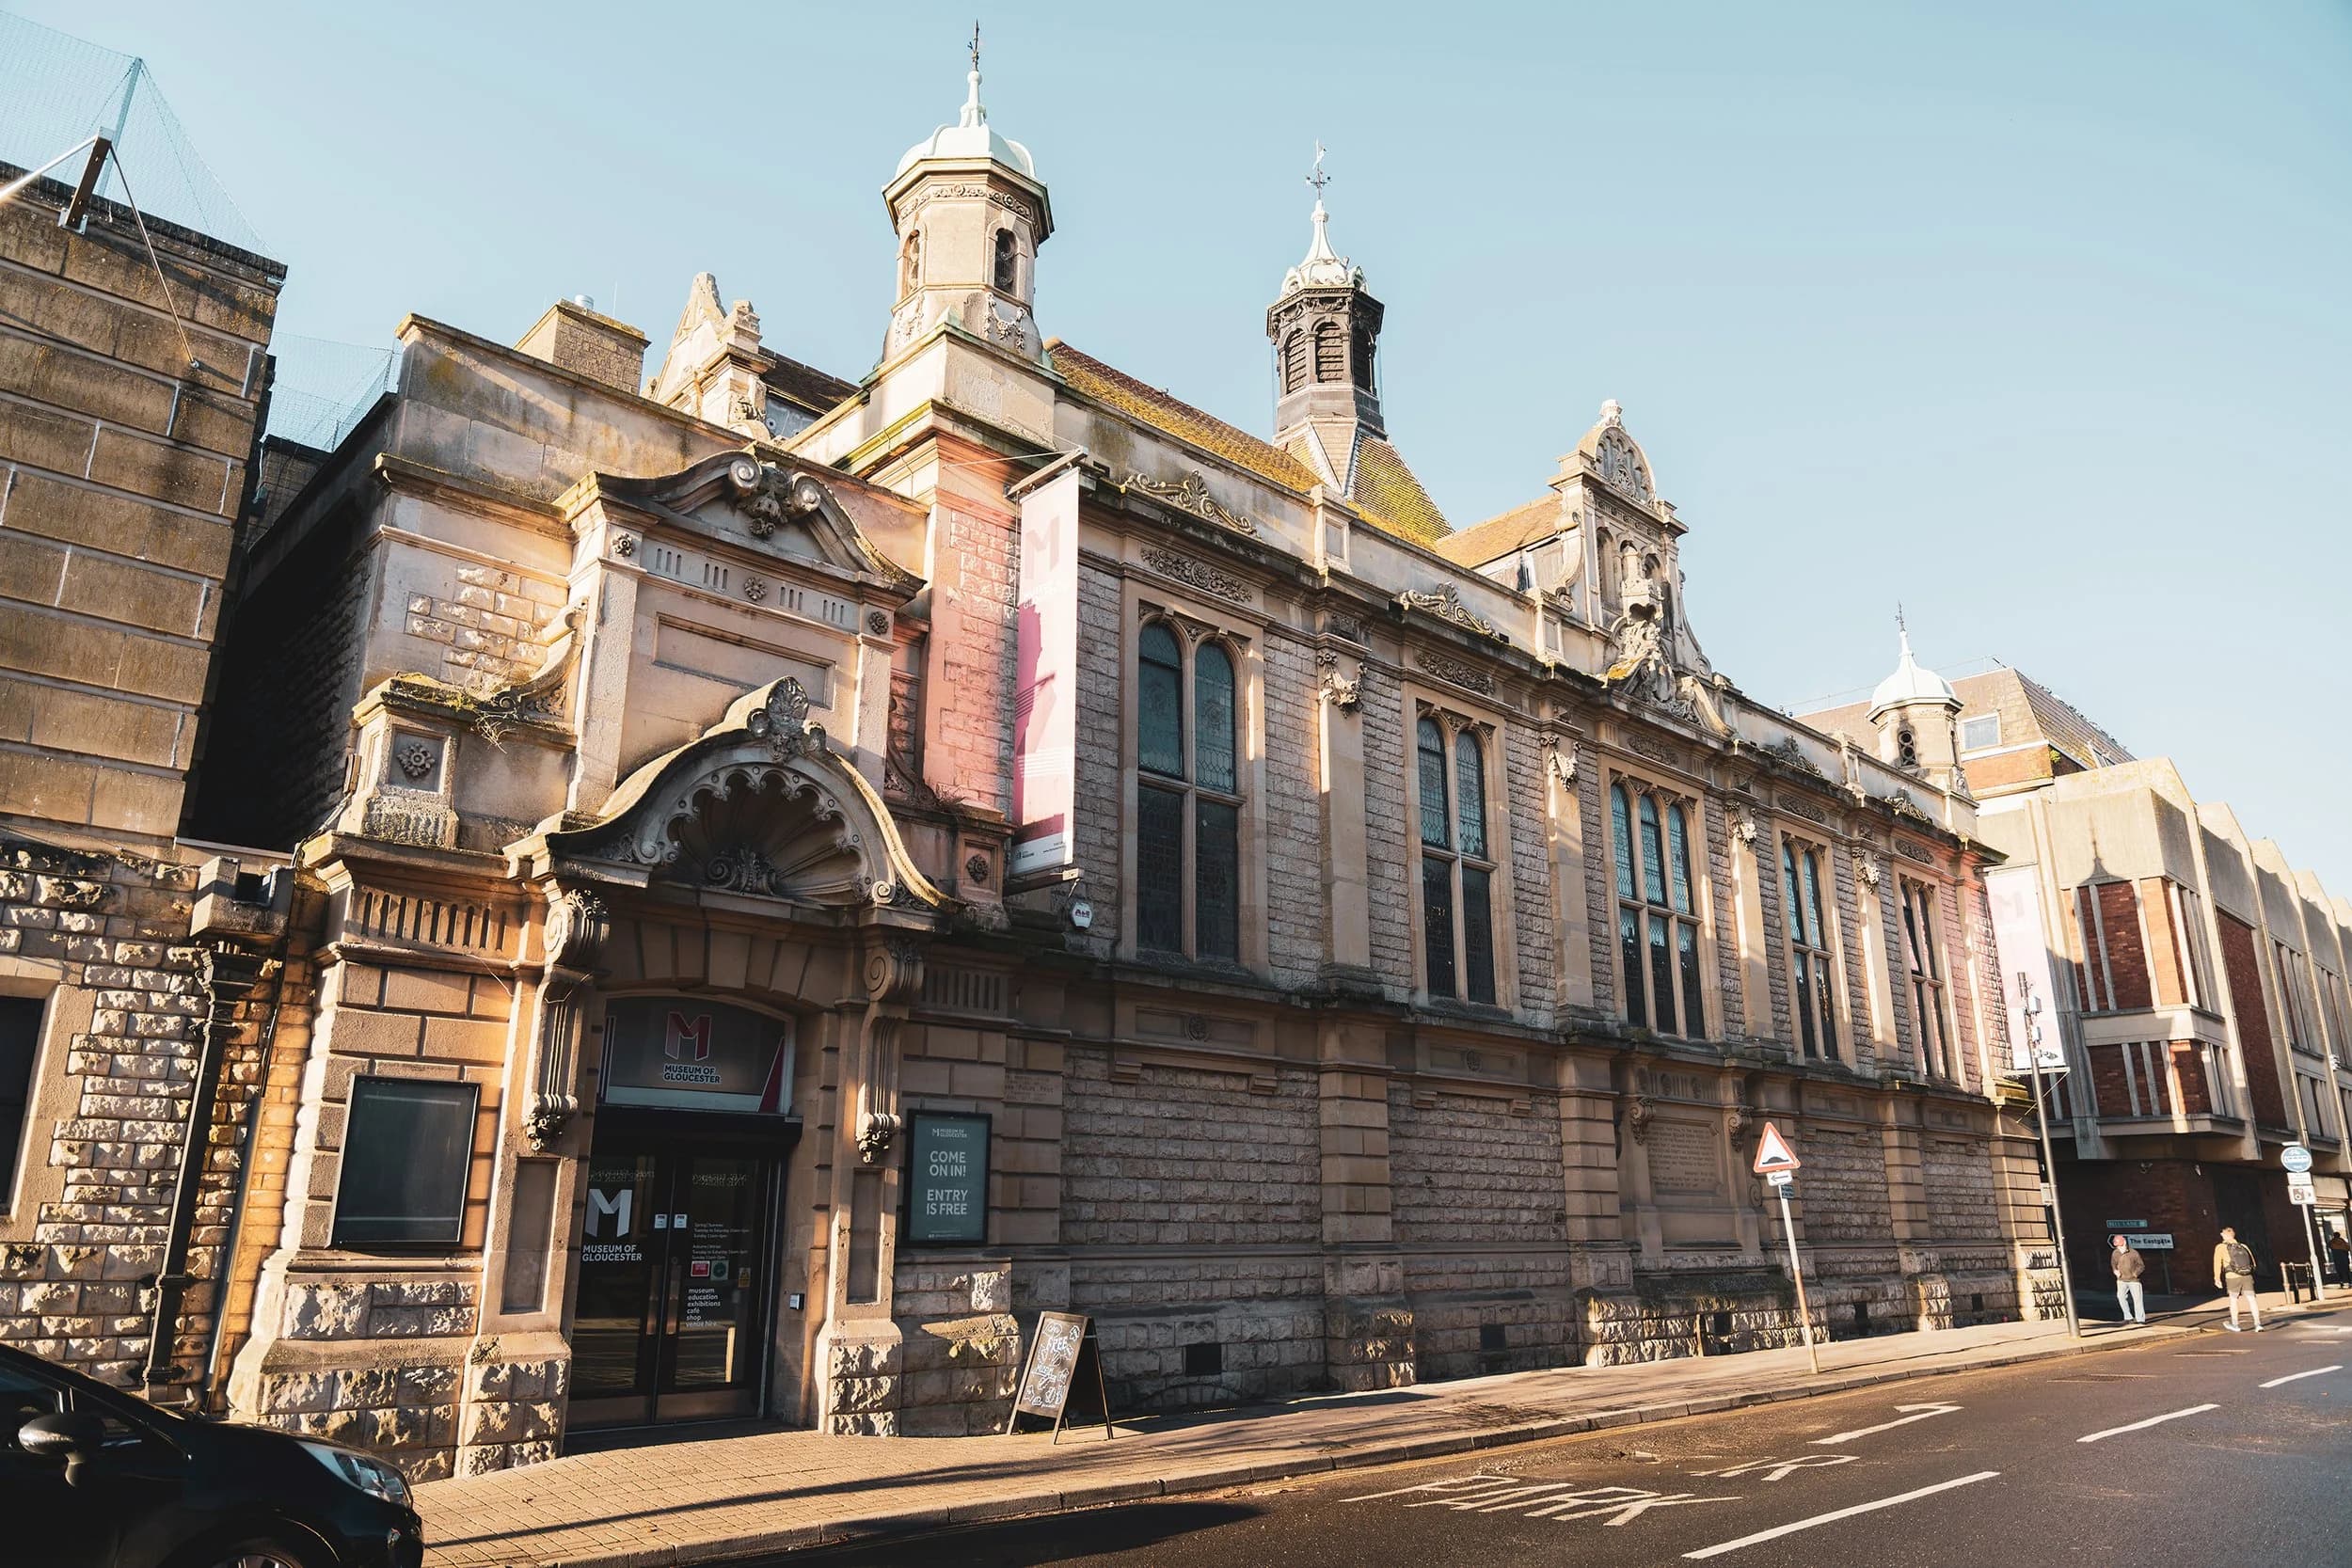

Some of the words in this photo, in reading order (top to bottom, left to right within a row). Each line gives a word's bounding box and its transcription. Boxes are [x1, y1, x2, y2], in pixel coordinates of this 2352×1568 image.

[664, 1009, 712, 1061] M
[663, 1064, 701, 1075] MUSEUM
[663, 1072, 721, 1084] GLOUCESTER
[930, 1150, 966, 1164] COME
[930, 1164, 948, 1177] ON
[950, 1164, 966, 1177] IN!
[927, 1188, 968, 1201] ENTRY
[584, 1188, 633, 1238] M
[926, 1202, 937, 1215] IS
[939, 1203, 968, 1215] FREE
[582, 1243, 623, 1254] MUSEUM
[624, 1244, 636, 1253] OF
[581, 1252, 643, 1262] GLOUCESTER
[1338, 1474, 1744, 1527] PARK
